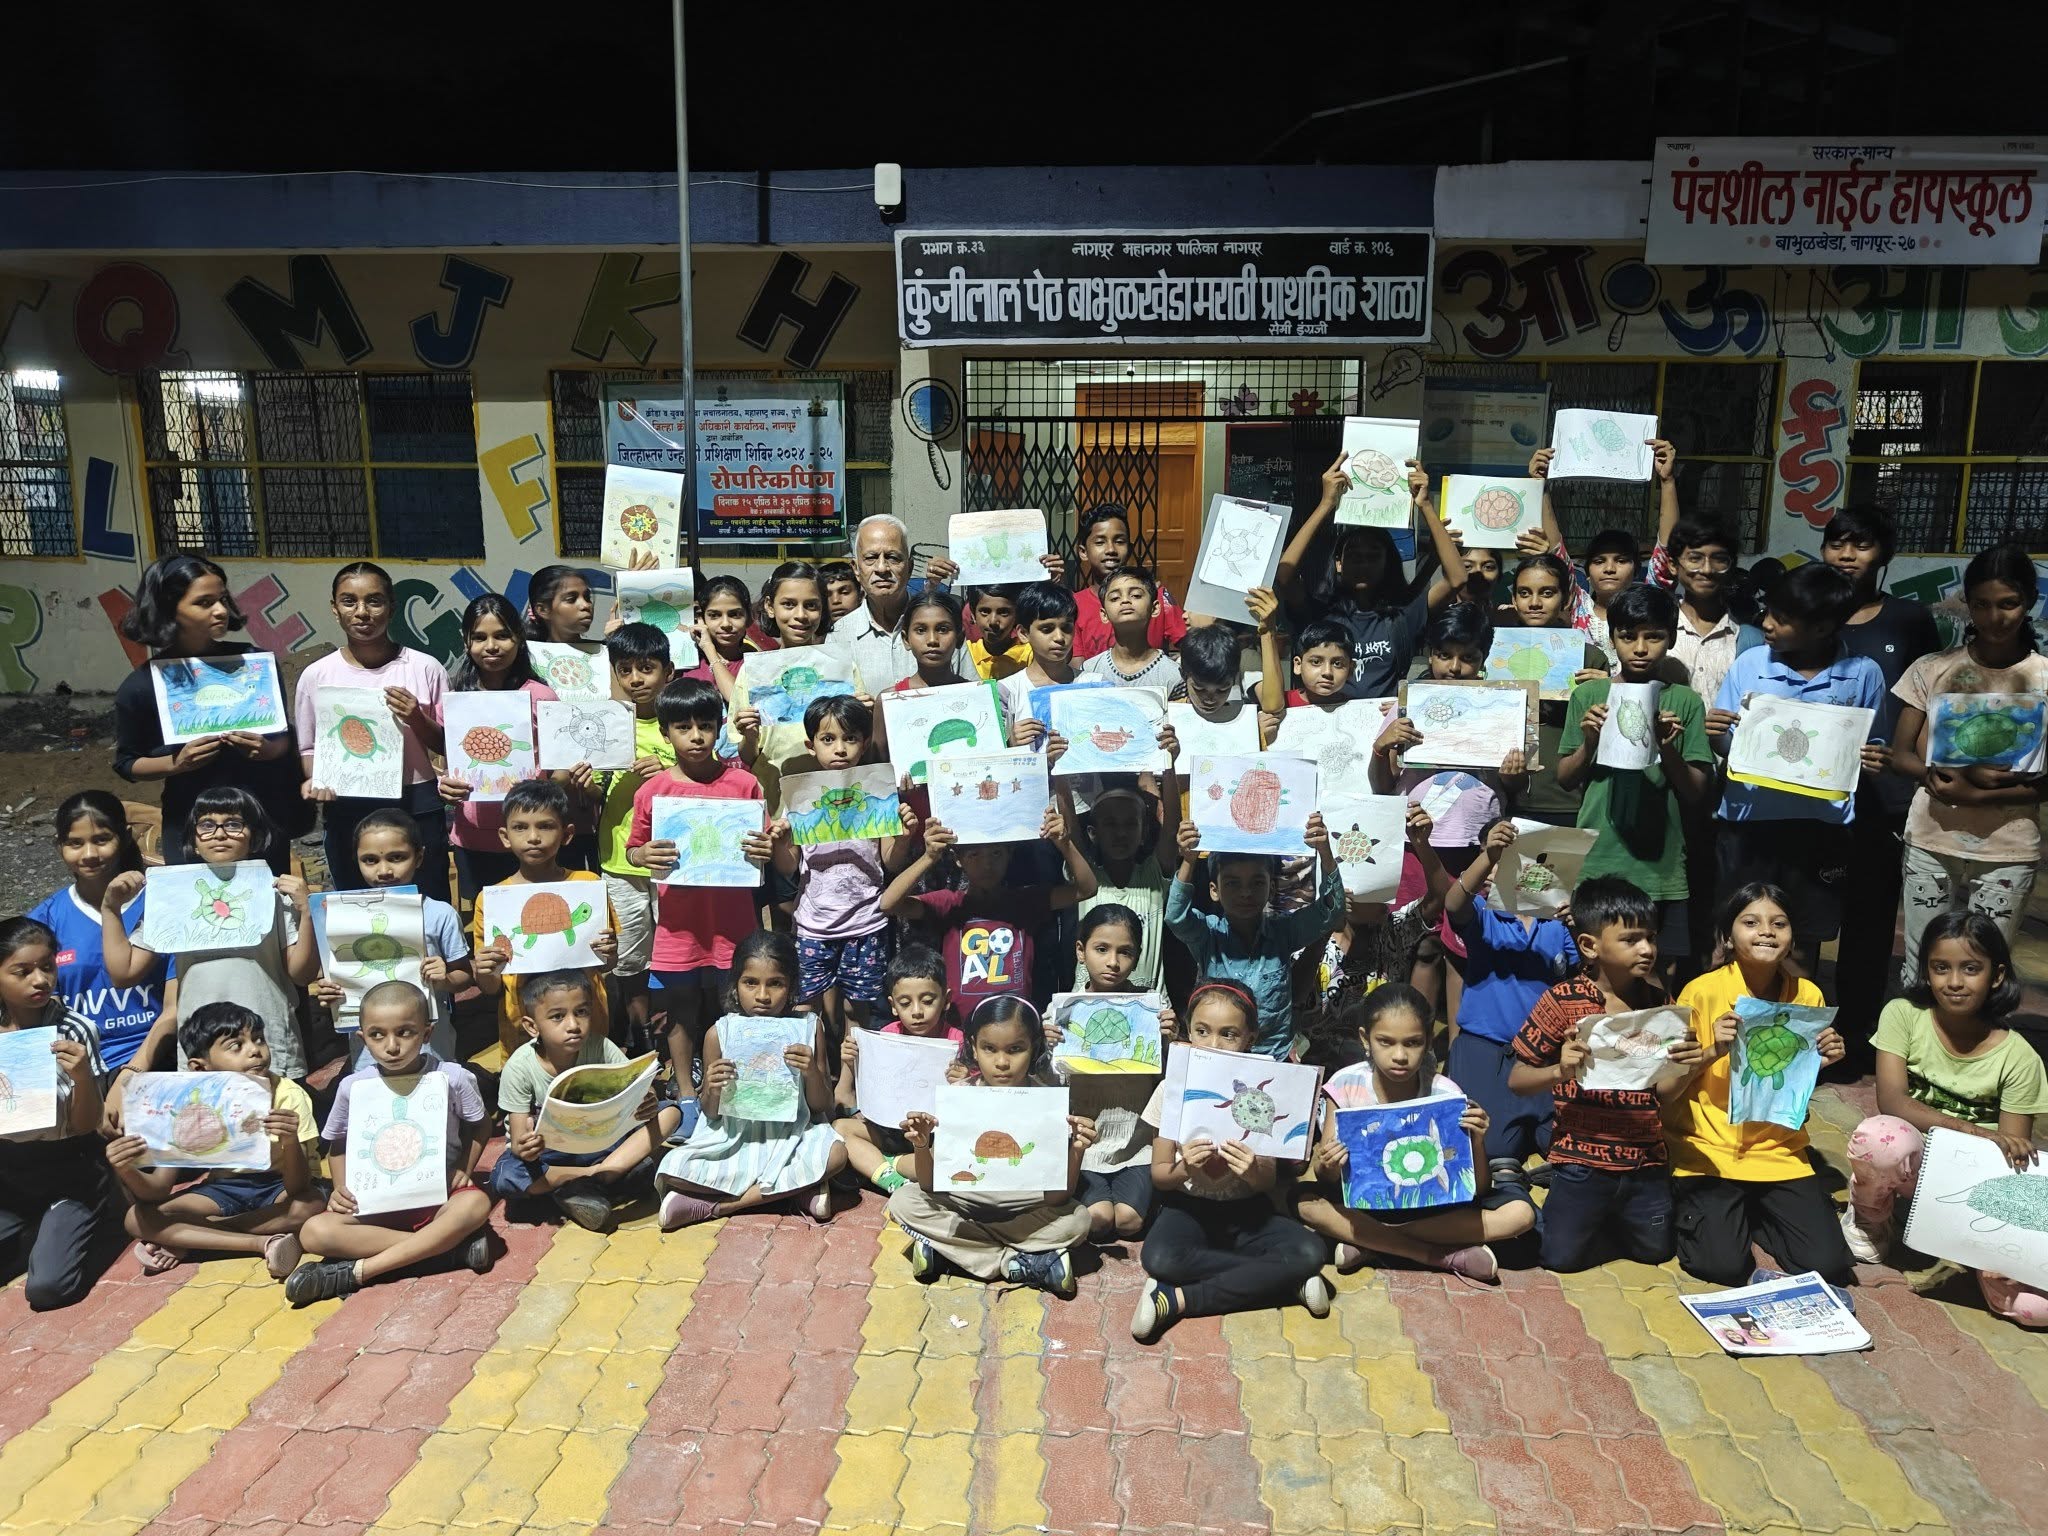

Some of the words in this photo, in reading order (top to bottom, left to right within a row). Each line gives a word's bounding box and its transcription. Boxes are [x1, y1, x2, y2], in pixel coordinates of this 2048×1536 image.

[1671, 157, 1801, 225] पंचशील
[1803, 158, 1890, 232] नाईट
[1889, 170, 2037, 238] हायस्कूल
[920, 241, 953, 256] प्रभाग
[1072, 242, 1115, 260] नागपूर
[1122, 242, 1173, 257] महानगर
[1176, 239, 1219, 256] पालिका
[1223, 241, 1264, 257] नागपूर
[1329, 238, 1352, 255] वार्ड
[1776, 232, 1846, 255] बाभुळखेडा,
[572, 252, 695, 365] K
[737, 251, 861, 370] H
[903, 266, 1022, 336] कुंजीलाल
[1023, 268, 1064, 322] पेठ
[1067, 268, 1192, 333] बाभुळखेडा
[1192, 262, 1258, 321] मराठी
[1259, 264, 1356, 321] प्राथमिक
[1359, 275, 1425, 322] शाळा
[224, 255, 373, 369] M
[409, 254, 513, 369] J
[1269, 320, 1292, 336] सेमी
[699, 419, 730, 431] अधिकारी
[772, 421, 796, 433] नागपूर
[704, 442, 740, 462] प्रशिक्षण
[777, 446, 805, 460] २०२४
[710, 463, 835, 489] रोपस्किपिंग
[475, 433, 551, 544] F
[82, 456, 137, 563] L
[718, 495, 740, 507] दिनांक
[104, 1010, 156, 1030] GROUP
